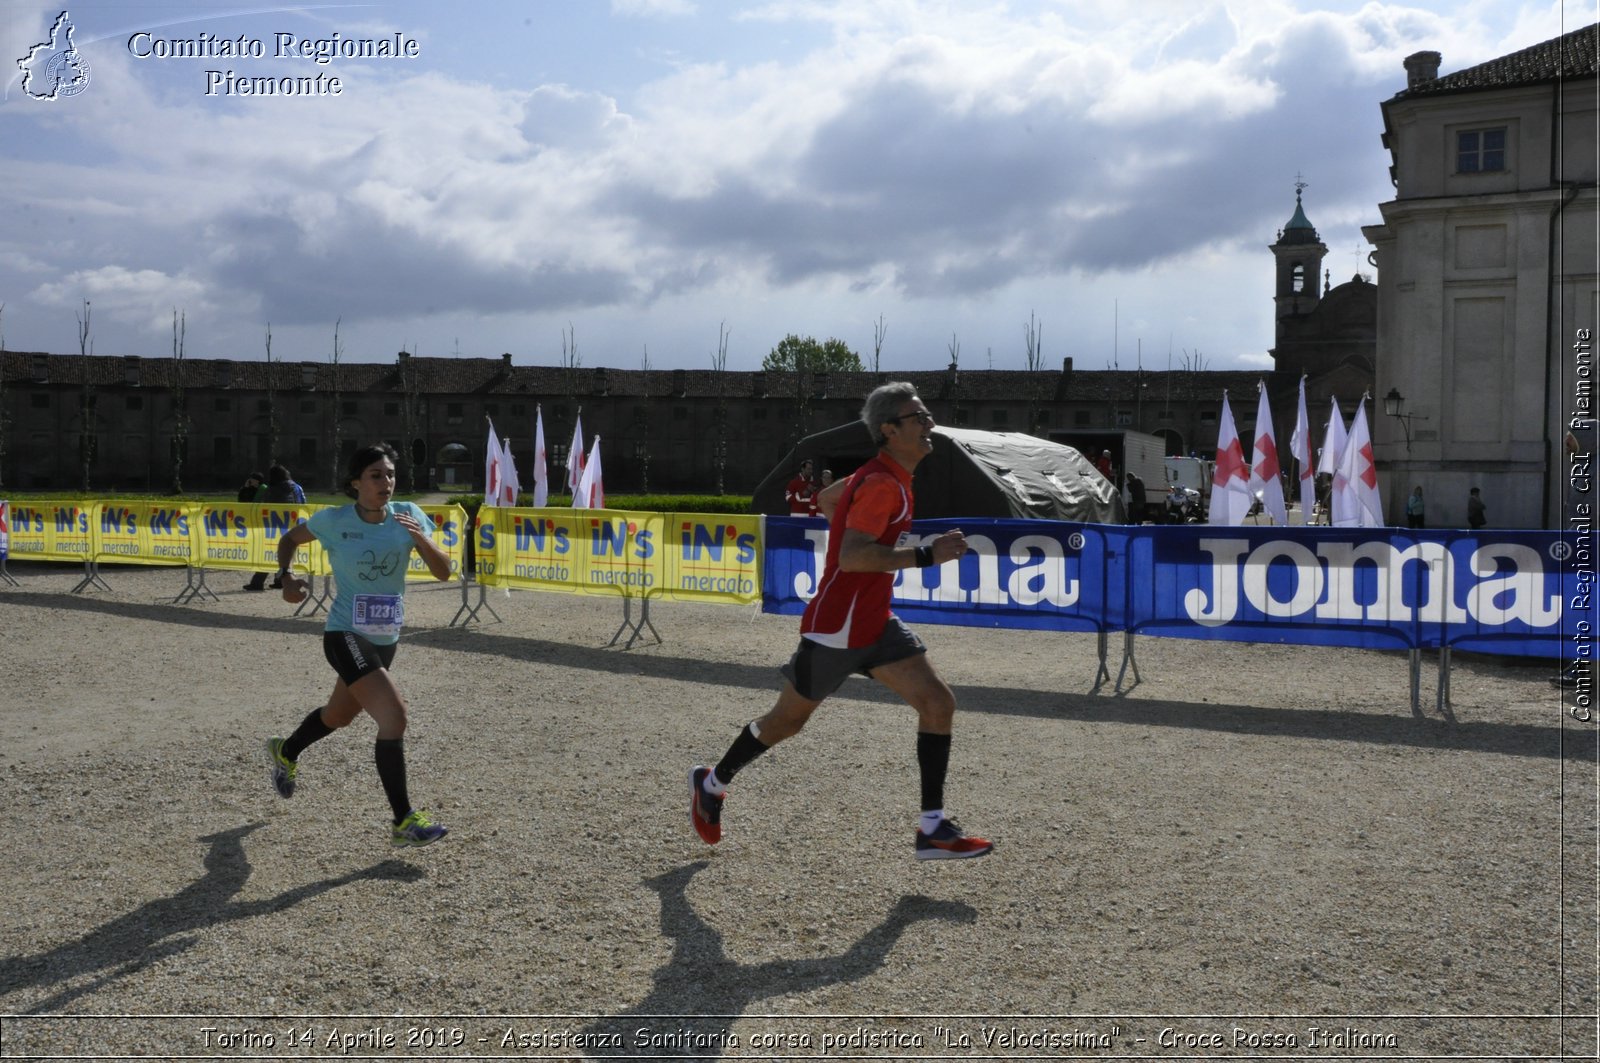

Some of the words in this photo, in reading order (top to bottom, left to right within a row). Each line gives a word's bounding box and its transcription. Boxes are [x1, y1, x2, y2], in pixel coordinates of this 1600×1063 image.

[54, 506, 88, 533] iN's
[102, 506, 137, 534] iN's
[151, 507, 189, 536] iN's
[203, 509, 248, 538] iN's
[56, 540, 90, 553] mercato
[514, 516, 570, 553] iN's
[591, 518, 654, 558] iN's
[682, 521, 756, 564] iN's
[103, 541, 139, 555] mercato
[153, 543, 191, 557] mercato
[207, 545, 248, 560] mercato
[514, 560, 569, 581] mercato
[591, 566, 654, 587] mercato
[794, 529, 1079, 607] Jma
[682, 572, 753, 594] mercato
[369, 604, 395, 619] 1231
